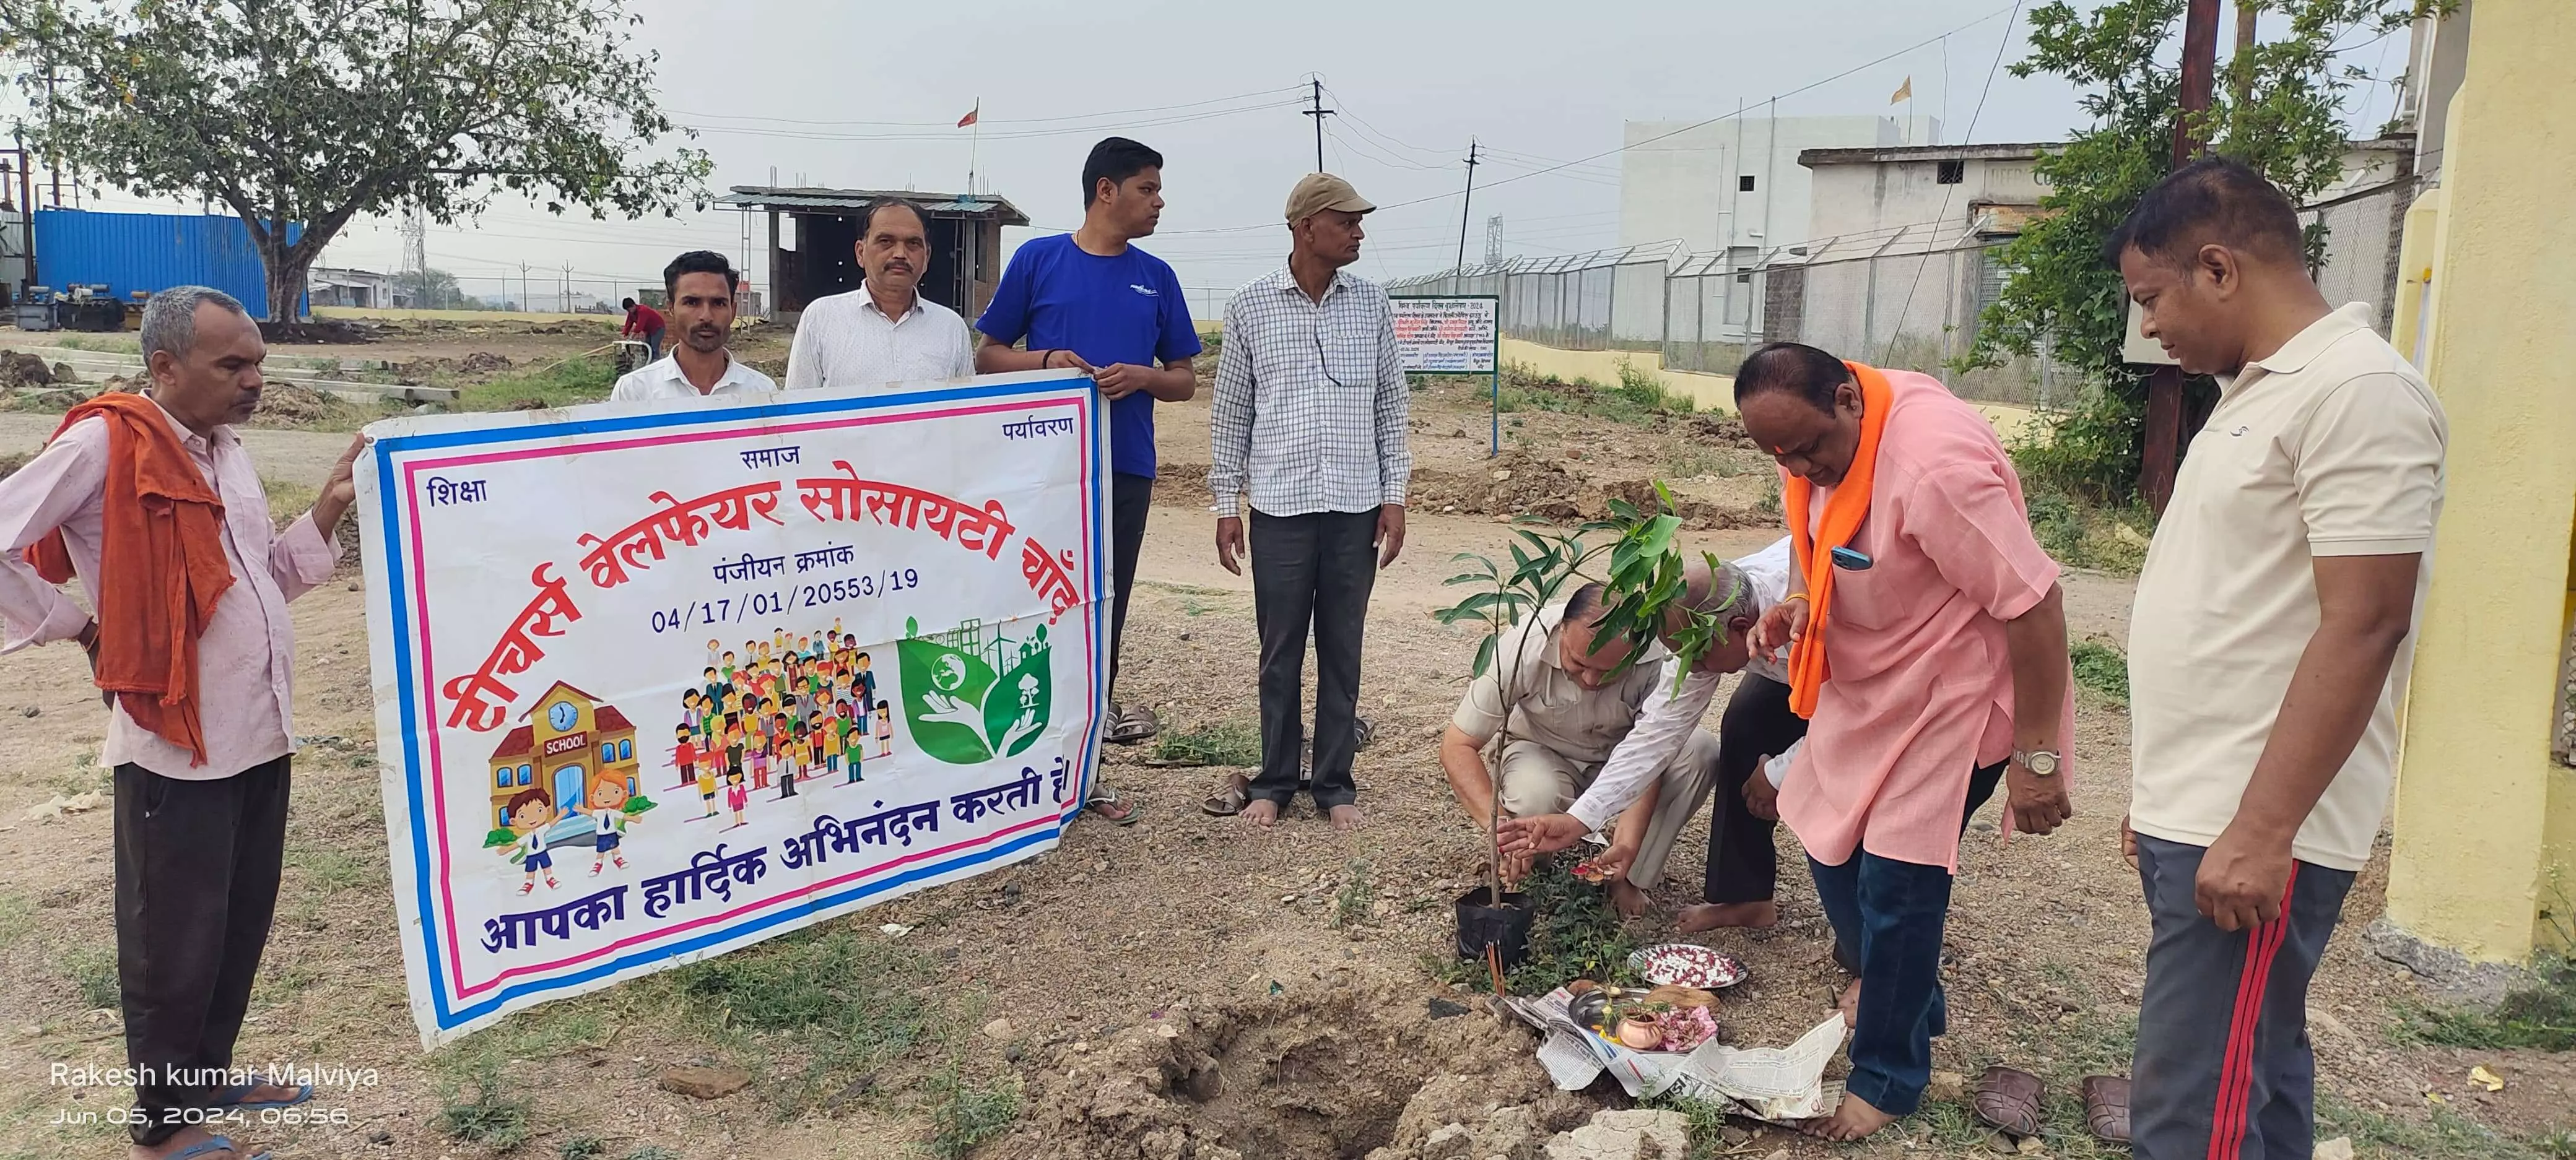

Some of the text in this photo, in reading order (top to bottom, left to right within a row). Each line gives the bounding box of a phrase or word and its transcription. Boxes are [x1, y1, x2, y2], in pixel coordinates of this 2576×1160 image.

[1003, 415, 1073, 440] पर्यावरण
[741, 446, 801, 469] समाज
[426, 477, 487, 507] शिक्षा
[713, 541, 854, 584] पंजीयन क्रमांक
[443, 563, 582, 732] टीचर्स
[578, 481, 785, 588] वेलफेयर
[796, 461, 1015, 560] सोसायटी
[546, 735, 585, 754] SCHOOL
[481, 885, 628, 954] आपका
[642, 843, 767, 919] हार्दिक
[780, 800, 941, 870] अभिनंदन
[951, 766, 1043, 823] करती
